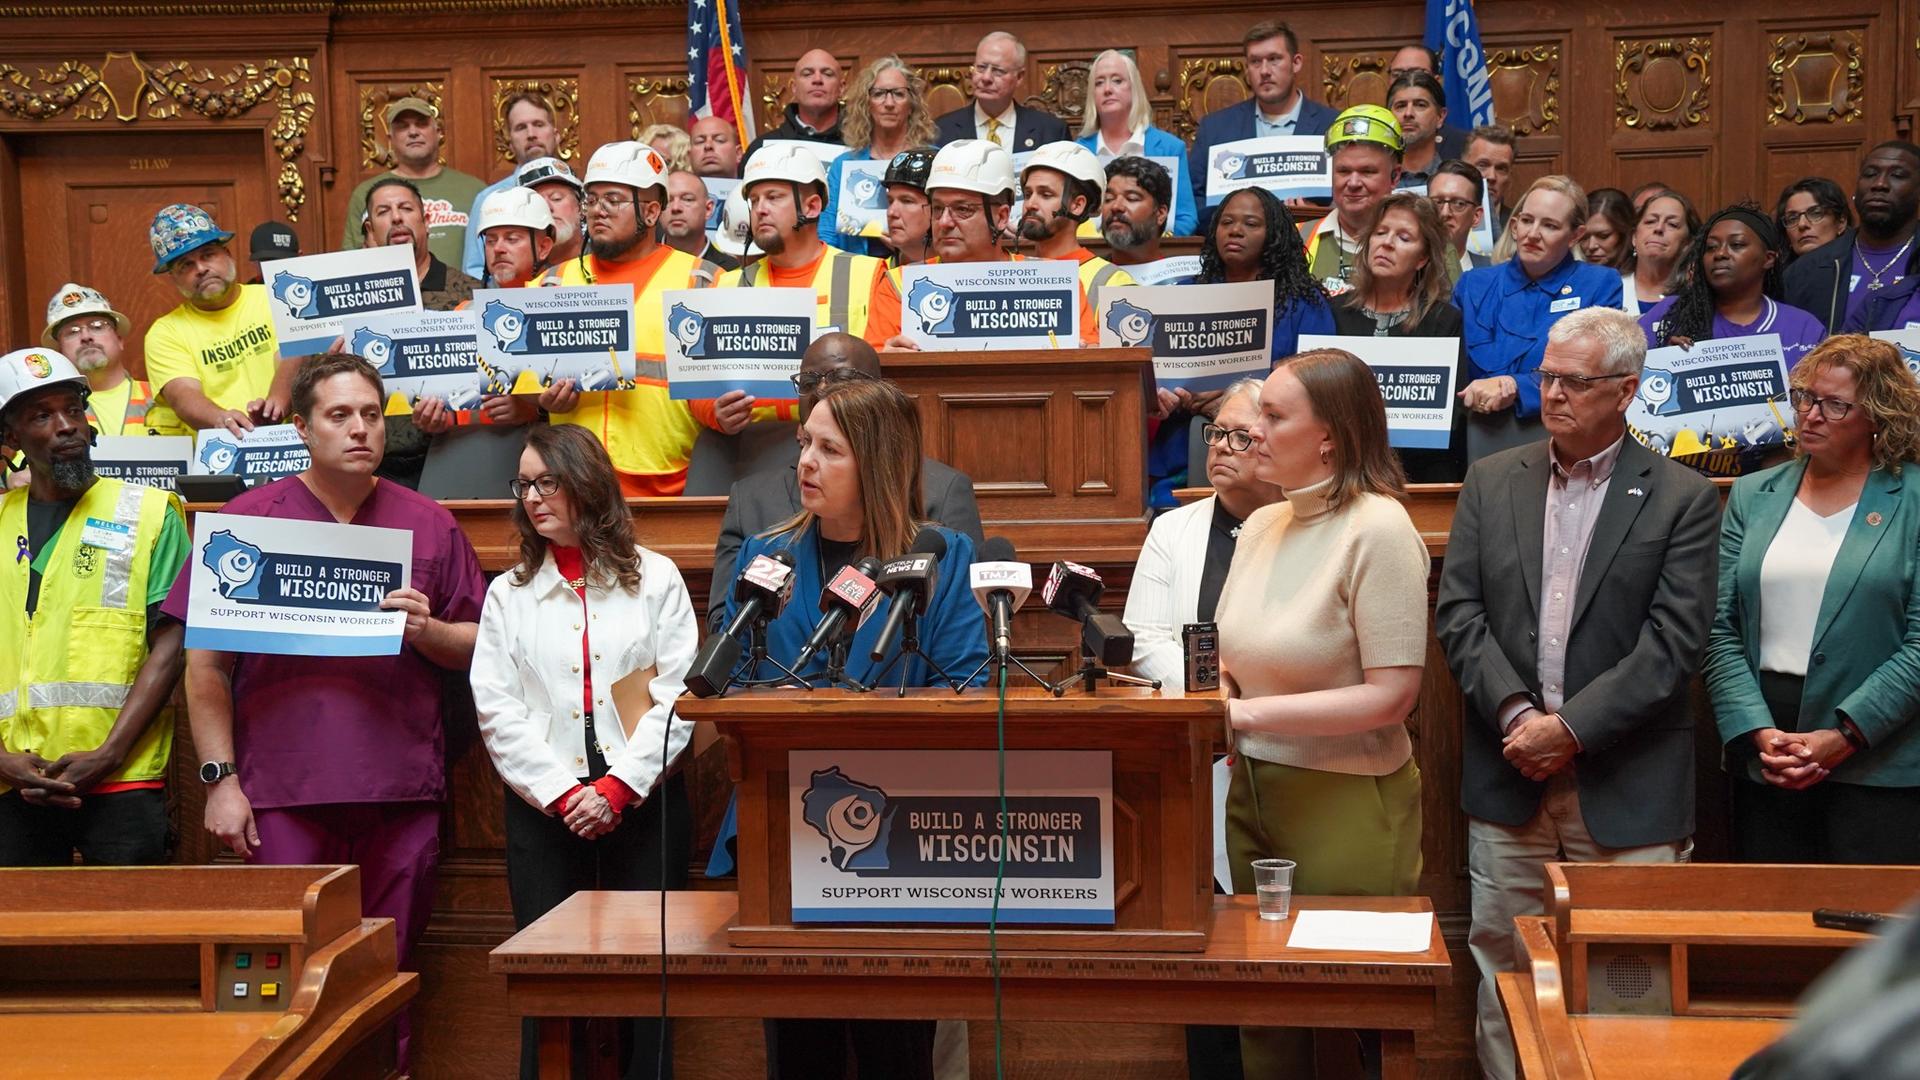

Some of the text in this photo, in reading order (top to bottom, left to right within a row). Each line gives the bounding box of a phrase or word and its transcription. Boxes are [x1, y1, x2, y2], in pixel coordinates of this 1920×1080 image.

[1256, 162, 1318, 174] WISCONSIN
[988, 269, 1038, 277] SUPPORT
[323, 276, 405, 296] BUILD A STRONGER
[955, 276, 1072, 286] WISCONSIN WORKERS
[329, 288, 404, 310] WISCONSIN
[554, 292, 598, 300] SUPPORT
[524, 298, 628, 309] WISCONSIN WORKERS
[965, 298, 1063, 311] BUILD A STRONGER
[290, 321, 328, 333] SUPPORT
[420, 317, 465, 327] SUPPORT
[536, 318, 621, 331] BUILD A STRONGER
[970, 311, 1058, 329] WISCONSIN
[1164, 317, 1258, 333] BUILD A STRONGER
[392, 323, 476, 335] WISCONSIN WORK
[712, 324, 801, 335] BUILD A STRONGER
[541, 330, 618, 347] WISCONSIN
[716, 336, 797, 352] WISCONSIN
[1169, 329, 1253, 350] WISCONSIN
[402, 341, 477, 355] BUILD A STRONG
[1701, 343, 1746, 355] SUPPORT
[407, 352, 478, 370] WISCONSI
[1163, 360, 1216, 369] WISCONSIN
[1218, 354, 1263, 365] WORKERS
[1670, 348, 1777, 368] WISCONSIN WORKERS
[678, 363, 800, 372] SUPPORT WISCONSIN WORKE
[1388, 373, 1394, 383] A
[1399, 373, 1442, 384] STRONGER
[1685, 368, 1774, 388] BUILD A STRONGER
[1379, 385, 1436, 401] SCONSIN
[1692, 380, 1774, 404] WISCONSIN
[245, 449, 310, 461] BUILD A STRON
[93, 466, 179, 476] BUILD A STRONGER
[246, 458, 312, 474] WISCONSI
[94, 520, 122, 529] HELLO
[275, 563, 391, 583] BUILD A STRONGER
[746, 559, 791, 581] 27
[886, 564, 912, 574] NEWS
[280, 578, 385, 603] WISCONSIN
[210, 607, 395, 625] SUPPORT WISCONSIN WORKERS
[909, 812, 1082, 831] BUILD A STRONGER
[918, 834, 1075, 863] WISCONSIN
[821, 886, 1098, 900] SUPPORT WISCONSIN WORKERS
